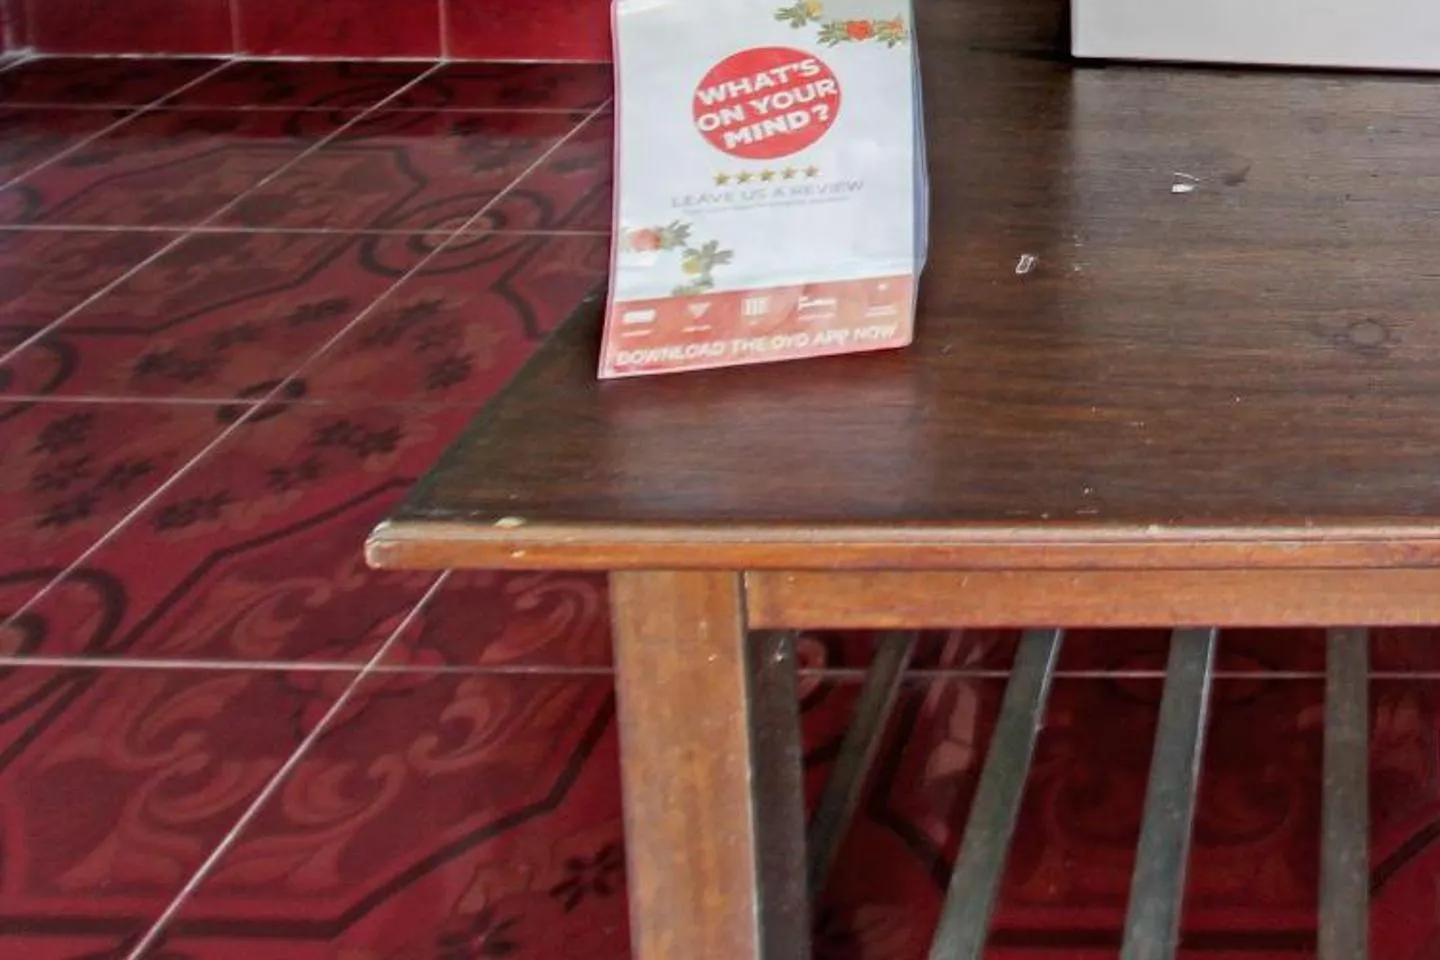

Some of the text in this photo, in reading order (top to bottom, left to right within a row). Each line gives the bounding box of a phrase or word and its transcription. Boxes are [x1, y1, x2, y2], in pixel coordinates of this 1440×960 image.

[697, 57, 821, 106] WHAT'S
[698, 78, 838, 132] ON YOUR
[671, 191, 736, 208] LEAVE
[789, 179, 865, 196] REVIEW
[615, 342, 726, 365] DOWNLOAD
[731, 335, 766, 356] THE
[812, 329, 850, 348] APP
[853, 322, 899, 341] NOW
